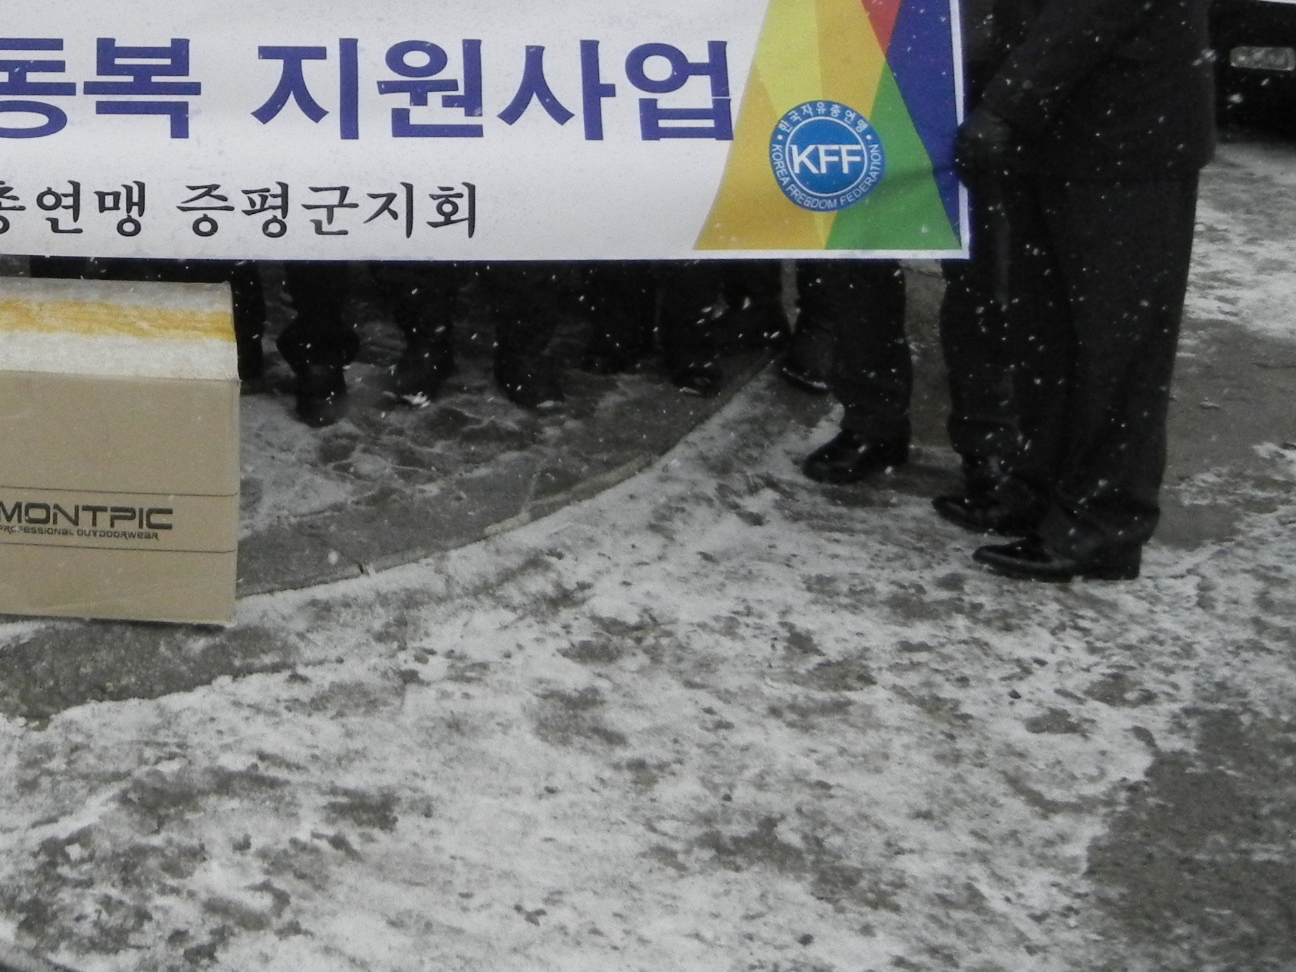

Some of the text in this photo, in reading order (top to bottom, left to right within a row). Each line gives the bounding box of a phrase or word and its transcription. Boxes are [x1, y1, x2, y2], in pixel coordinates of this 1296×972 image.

[251, 37, 735, 142] 지원사업
[777, 101, 869, 133] 한국자유총연맹
[771, 143, 882, 209] KOREA FREEDOM FEDERATION
[790, 144, 862, 174] KFF
[176, 181, 478, 241] 증평군지회
